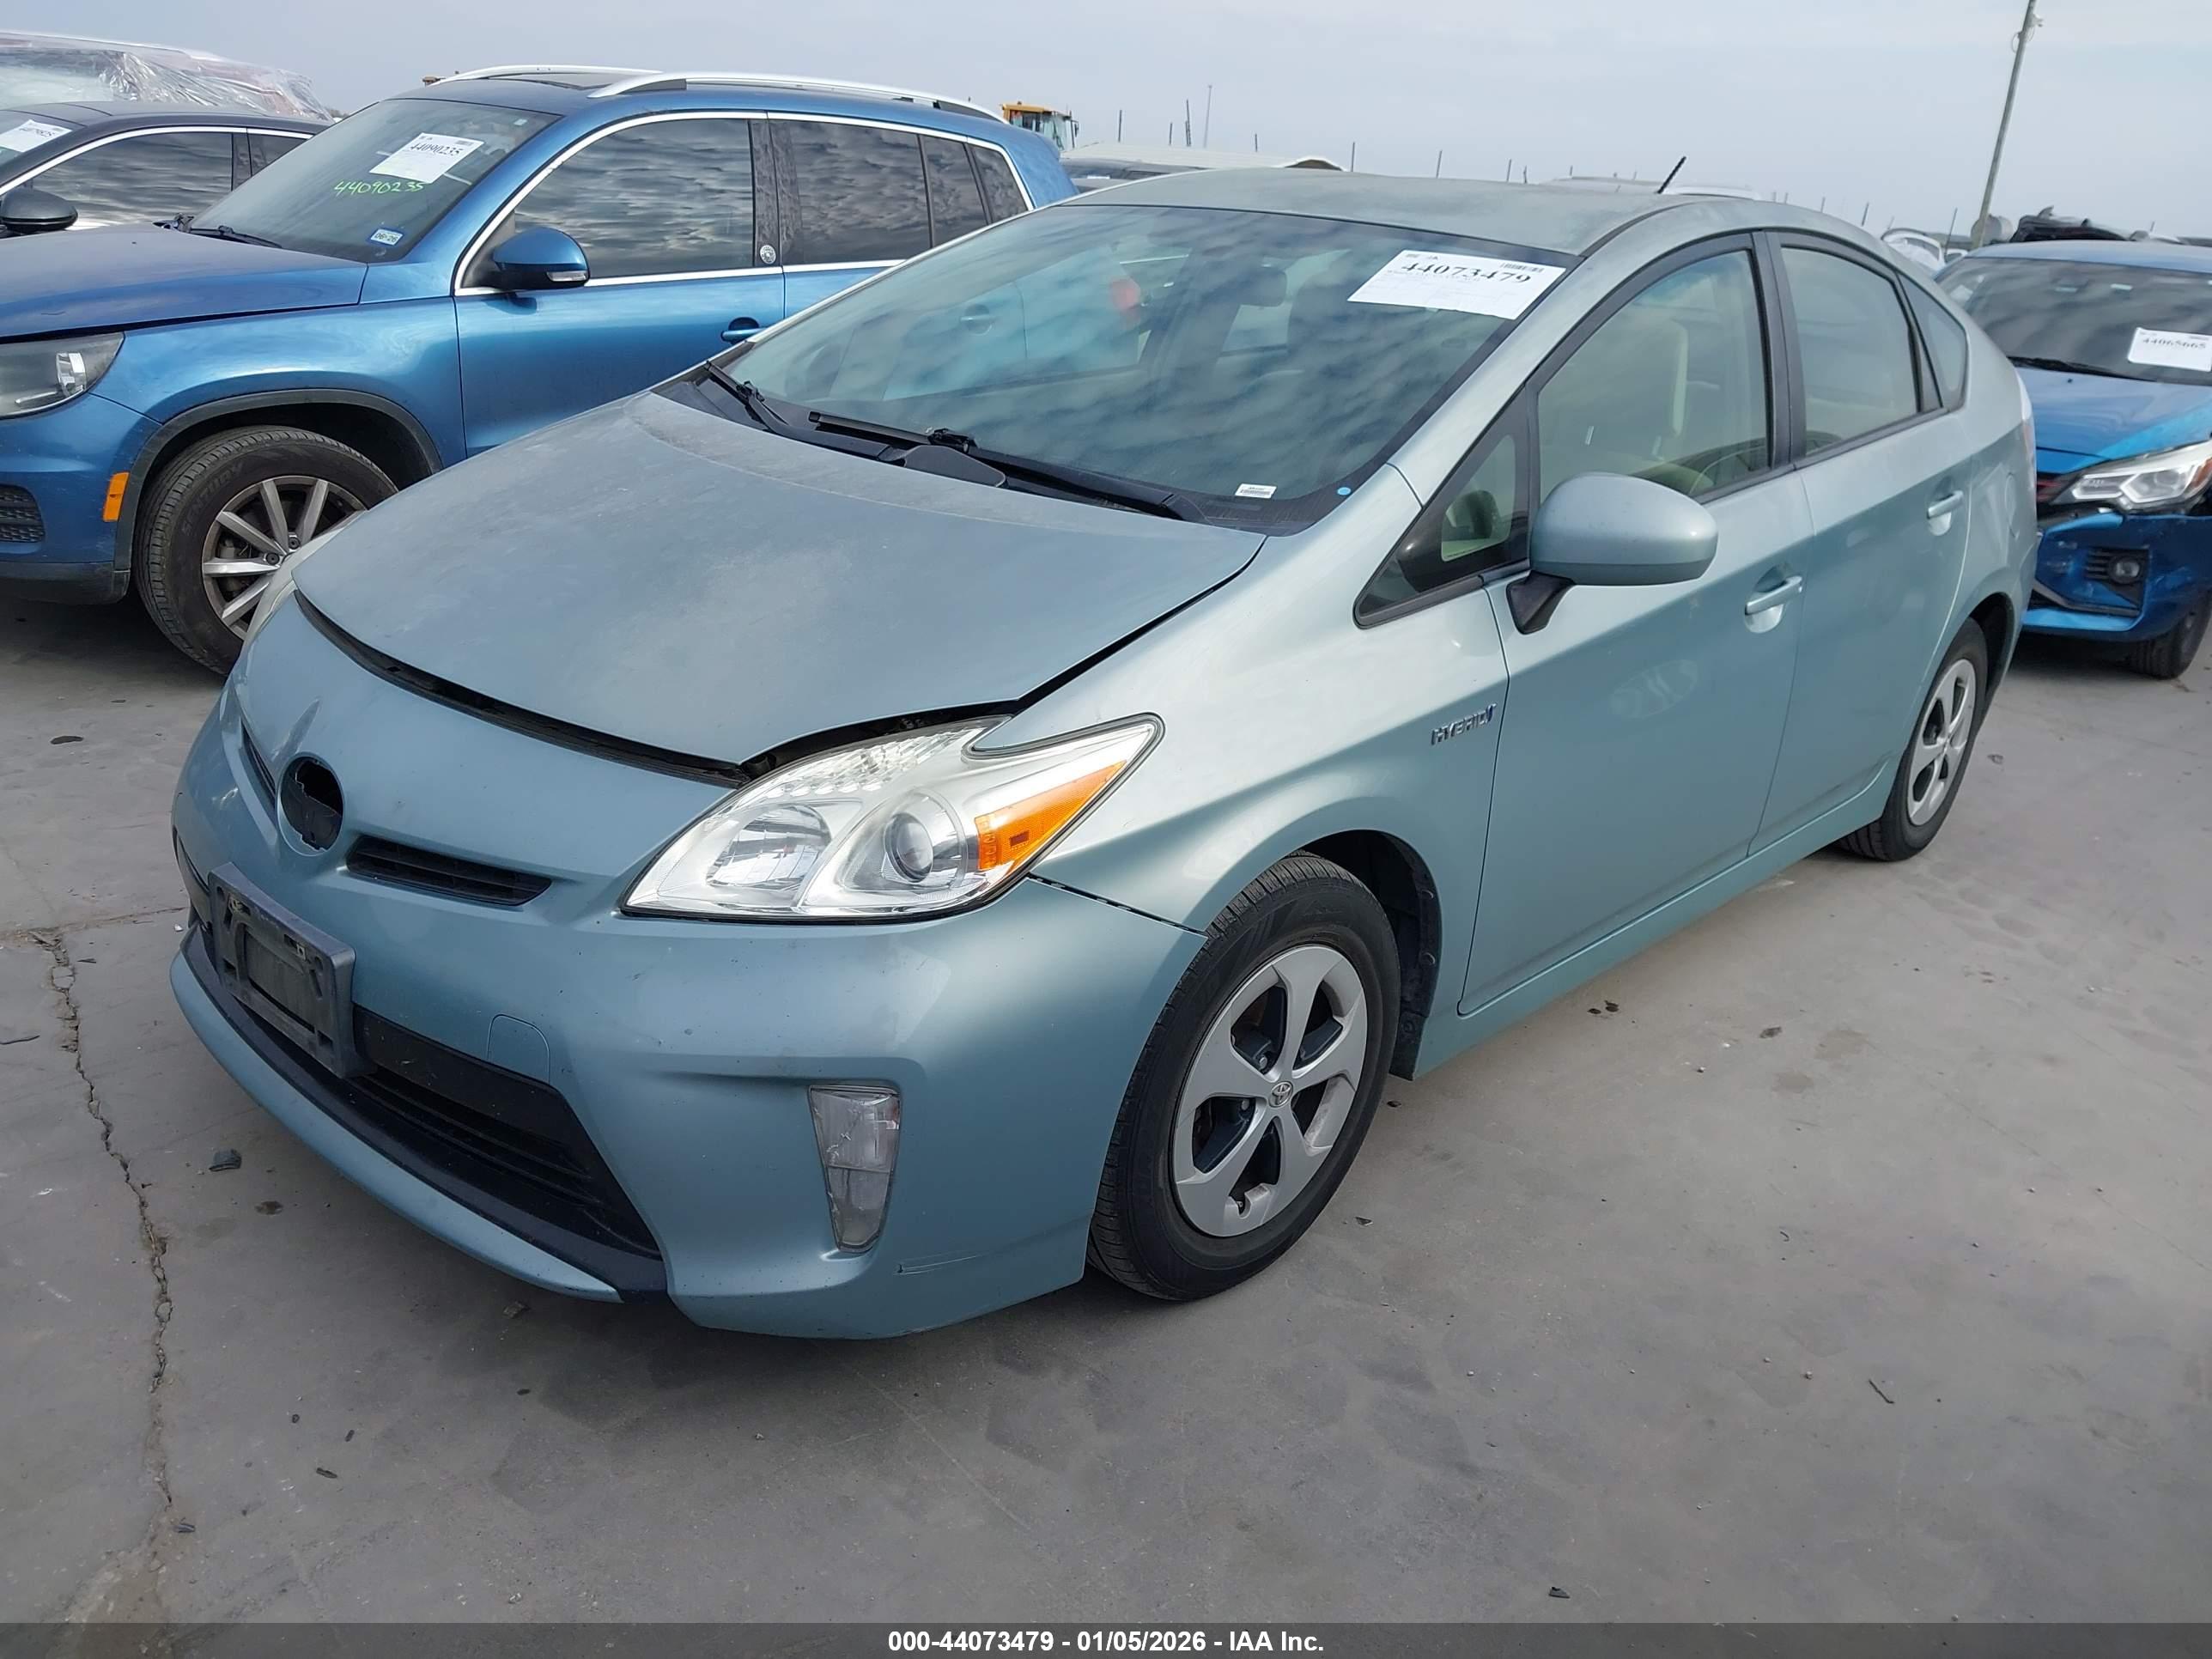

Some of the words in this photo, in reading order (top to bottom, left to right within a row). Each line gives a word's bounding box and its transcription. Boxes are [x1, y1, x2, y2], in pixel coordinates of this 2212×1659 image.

[410, 142, 465, 156] 44090235
[334, 180, 425, 196] 44090235
[1401, 262, 1532, 283] 44073479
[1431, 702, 1498, 745] HYBRID
